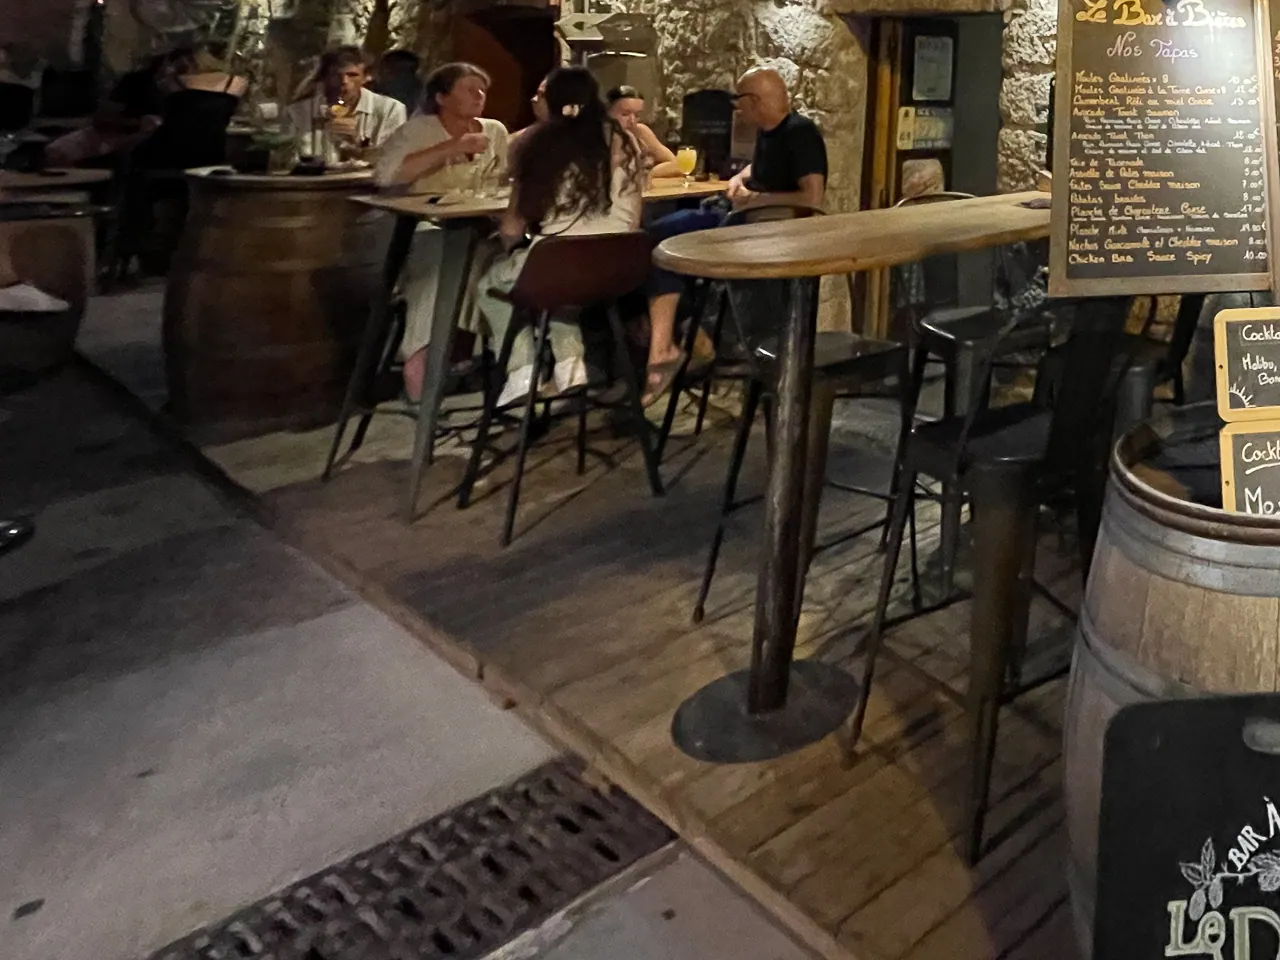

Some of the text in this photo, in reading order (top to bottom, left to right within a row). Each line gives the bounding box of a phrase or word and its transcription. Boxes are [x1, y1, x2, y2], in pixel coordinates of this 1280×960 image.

[1107, 31, 1199, 64] Nos Tapas
[1186, 250, 1213, 265] Spicy
[1227, 824, 1268, 872] BAR
[1164, 899, 1227, 960] Le
